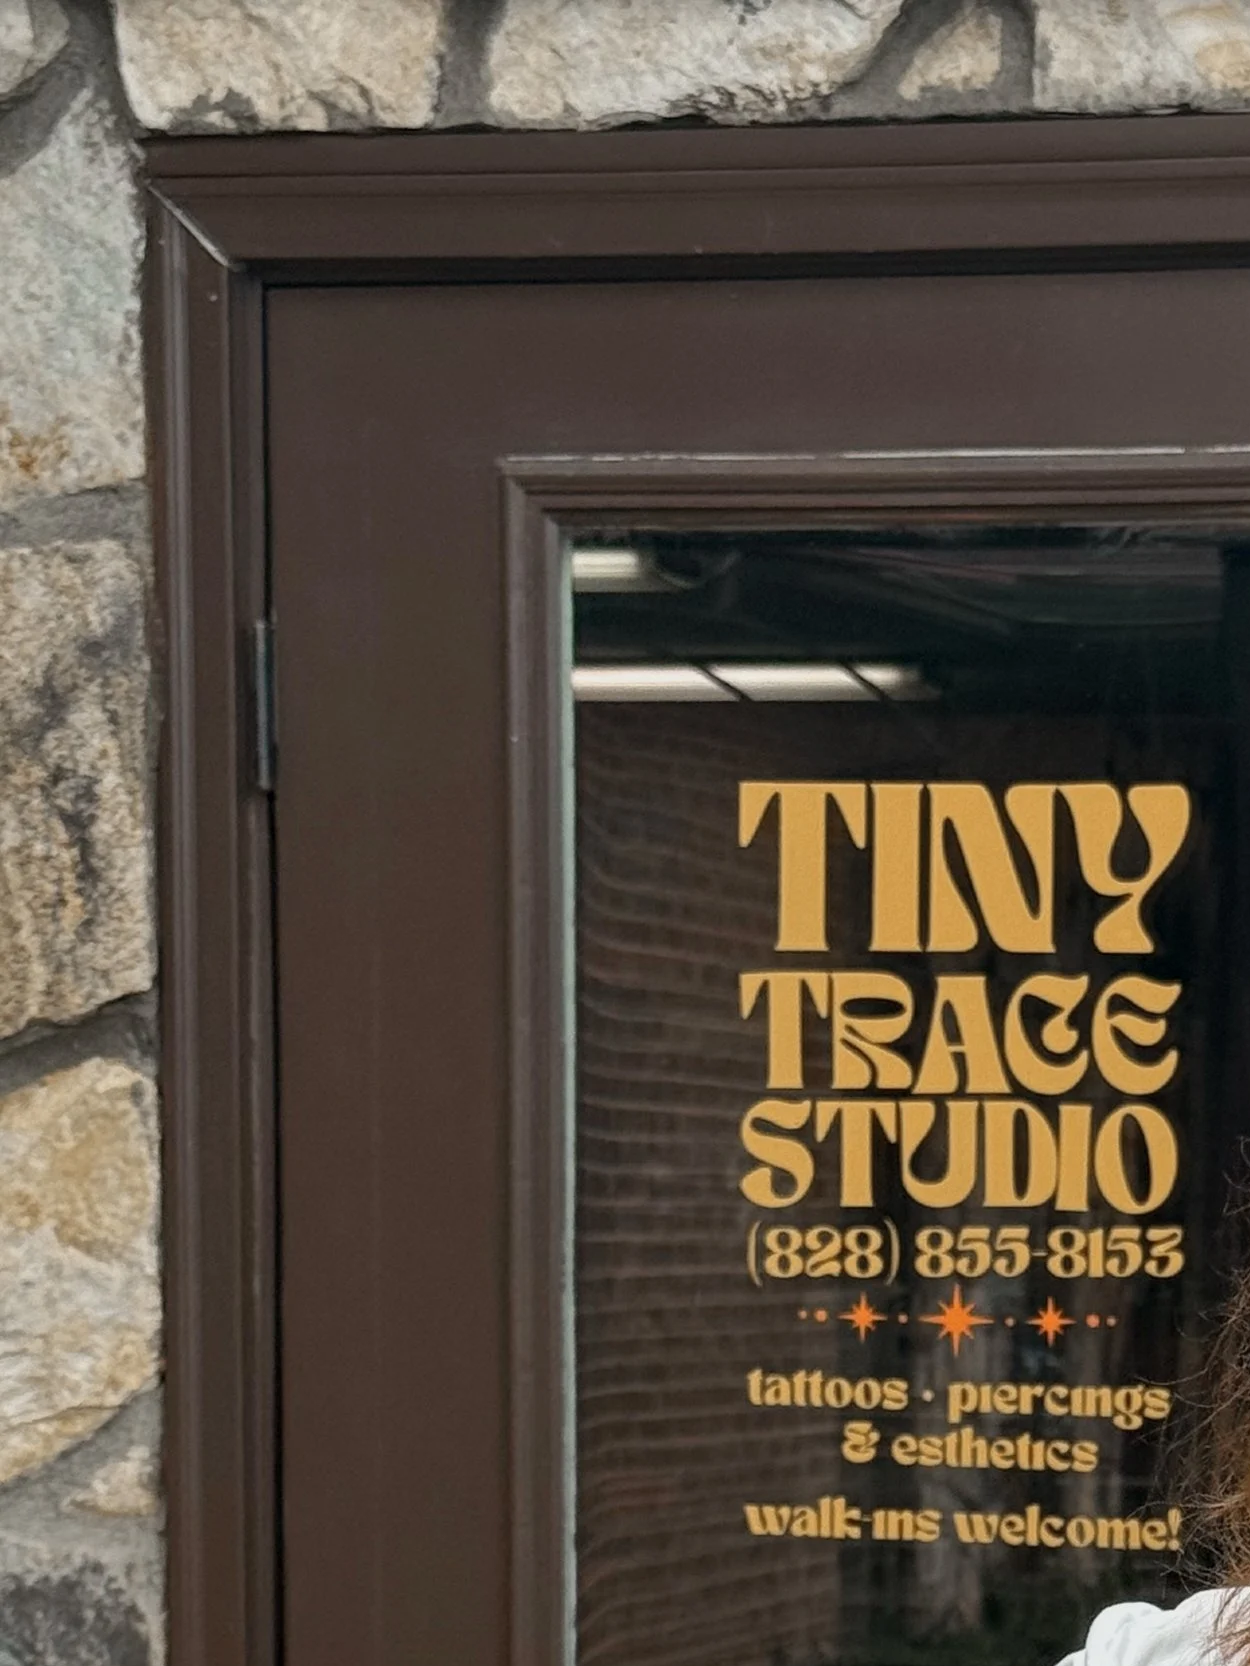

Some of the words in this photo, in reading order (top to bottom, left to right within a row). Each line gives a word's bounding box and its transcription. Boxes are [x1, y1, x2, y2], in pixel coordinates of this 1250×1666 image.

[739, 782, 1190, 953] TINY
[740, 972, 1182, 1095] TRACE
[740, 1100, 1178, 1214] STUDIO
[747, 1220, 900, 1287] (828)
[914, 1225, 1185, 1279] 855-8153
[747, 1368, 909, 1409] tattoos
[947, 1381, 1173, 1430] piercings
[841, 1420, 880, 1463] &
[891, 1427, 1099, 1472] esthetics
[744, 1496, 943, 1542] walk-ins
[953, 1504, 1183, 1552] welcome!
